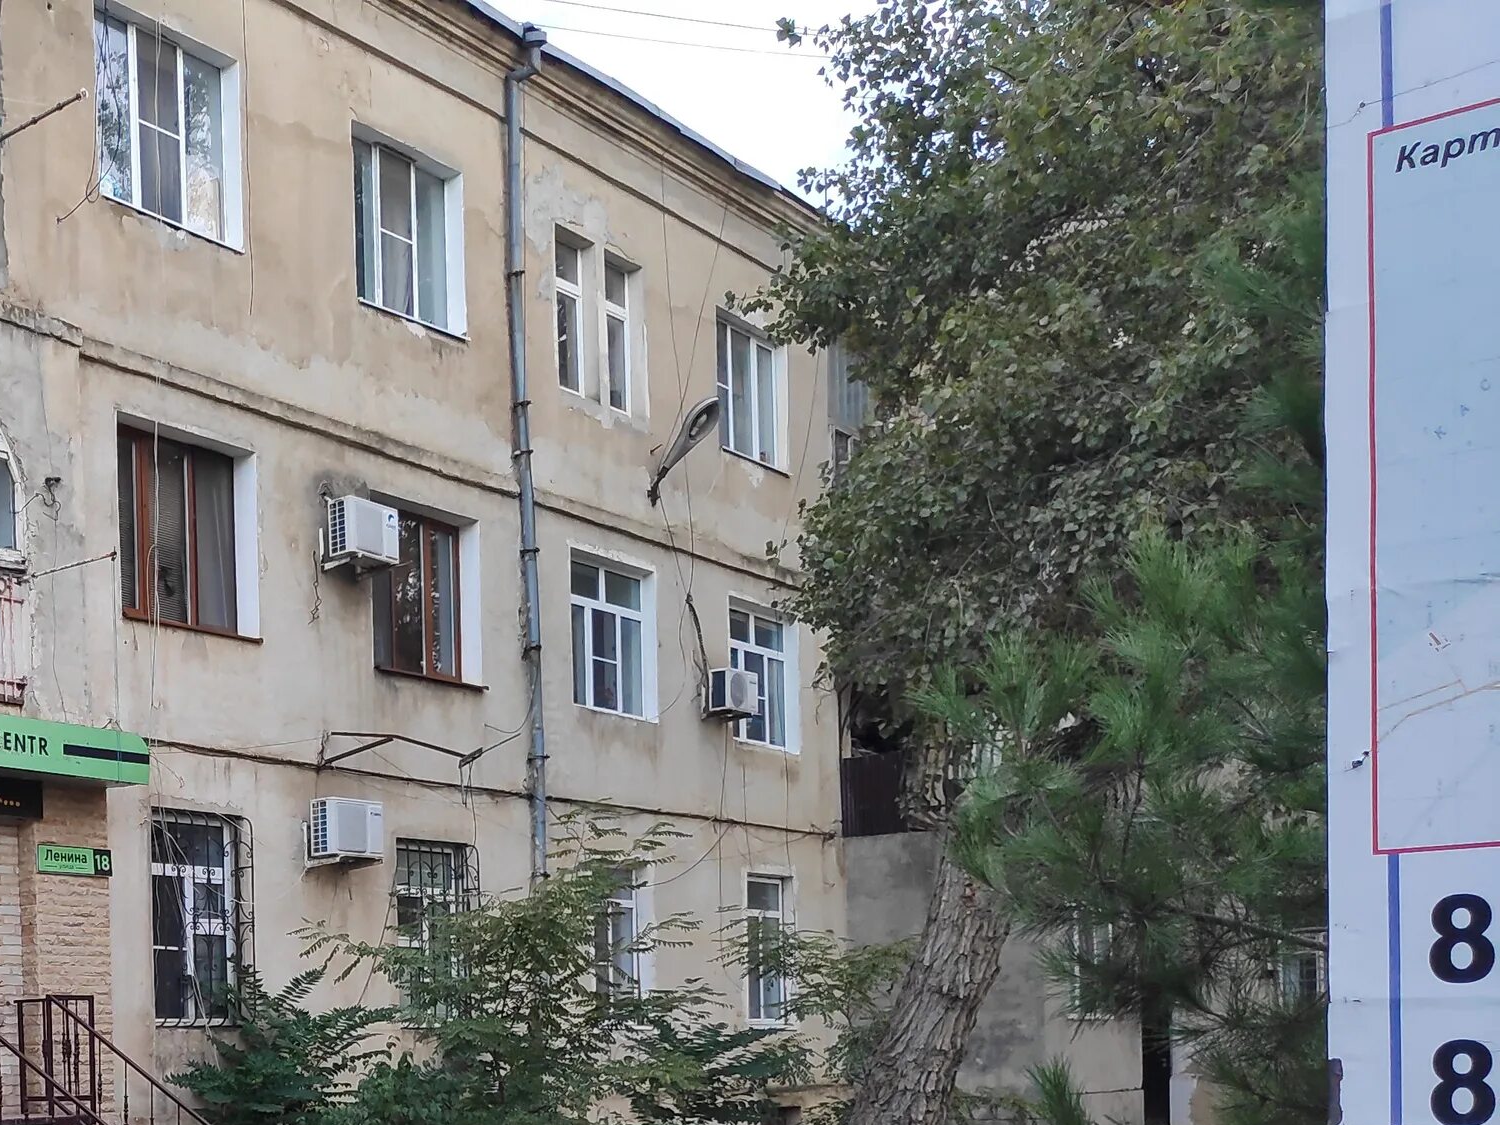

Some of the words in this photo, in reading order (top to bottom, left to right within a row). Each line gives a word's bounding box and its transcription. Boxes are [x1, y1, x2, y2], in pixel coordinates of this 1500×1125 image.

[44, 849, 88, 864] Ленина
[94, 854, 110, 872] 18
[1429, 893, 1495, 983] 8
